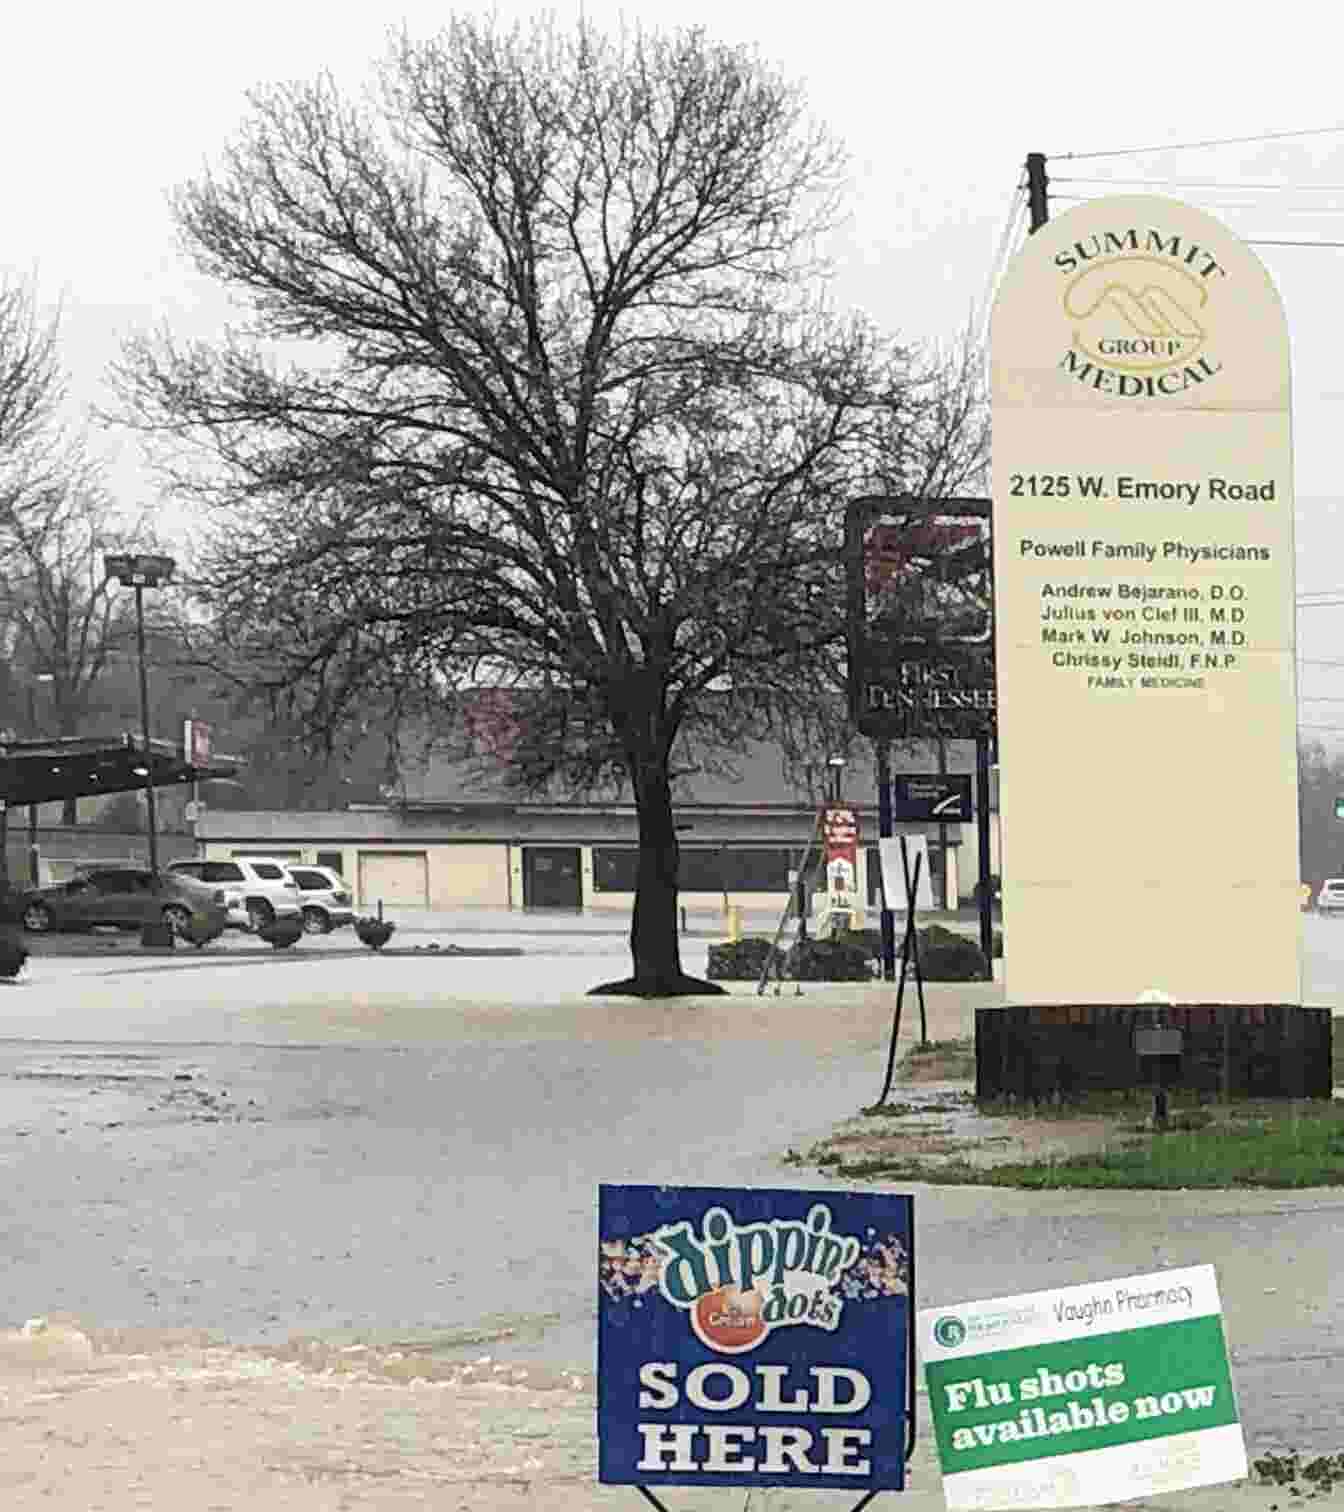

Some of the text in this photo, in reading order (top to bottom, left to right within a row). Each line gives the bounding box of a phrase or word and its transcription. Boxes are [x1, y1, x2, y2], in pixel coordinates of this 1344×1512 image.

[1054, 229, 1226, 279] SUMMIT
[1098, 337, 1184, 356] GROUP
[1060, 350, 1223, 397] MEDICAL
[1009, 475, 1276, 505] 2125 W. Emory Road
[1020, 540, 1271, 563] Powell Family Physicians
[1041, 584, 1112, 599] Andrew
[1041, 605, 1097, 621] Julius
[1103, 608, 1136, 621] von
[1041, 629, 1086, 643] Mark
[1052, 652, 1121, 671] Chrissy
[762, 1284, 836, 1323] dots
[1053, 1295, 1112, 1327] Vaughn
[640, 1362, 871, 1413] SOLD
[944, 1361, 1126, 1413] Flu shots
[951, 1384, 1217, 1450] available now
[637, 1424, 871, 1475] HERE
